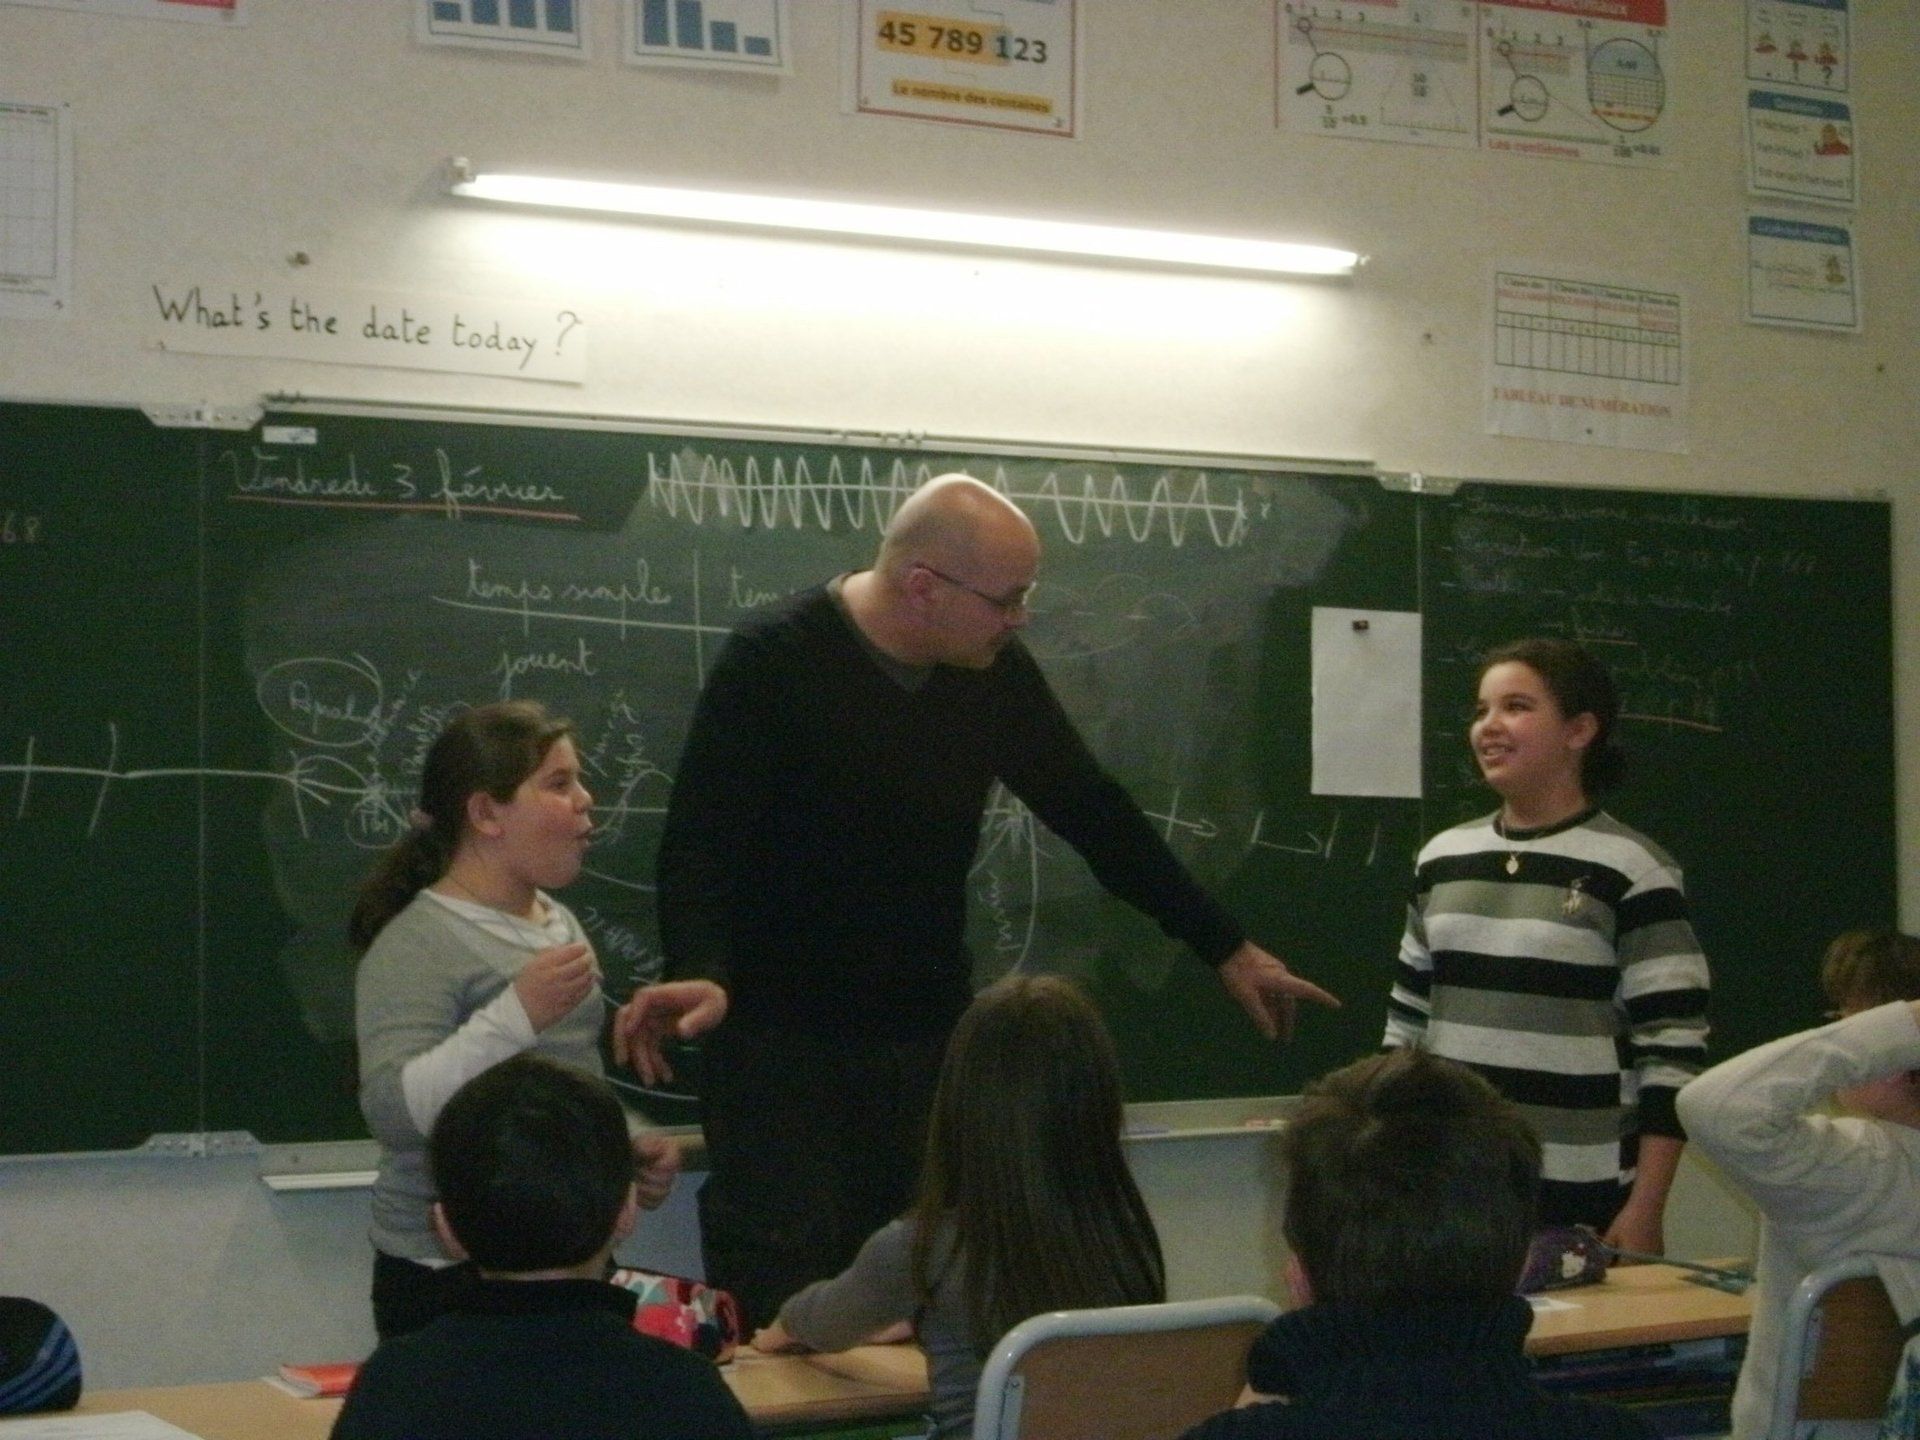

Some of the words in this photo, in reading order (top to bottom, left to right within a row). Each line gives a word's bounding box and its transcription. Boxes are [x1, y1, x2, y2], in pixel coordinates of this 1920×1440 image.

[879, 21, 916, 46] 45
[928, 26, 983, 54] 789
[996, 35, 1048, 64] 123
[153, 284, 271, 330] What's
[291, 298, 339, 335] the
[363, 305, 432, 346] date
[452, 314, 538, 370] today
[557, 310, 582, 356] ?
[220, 447, 377, 495] Vendredi
[393, 463, 417, 498] 3
[431, 448, 563, 519] février
[467, 557, 550, 637] temps
[561, 557, 672, 641] simple
[493, 637, 597, 700] jouent
